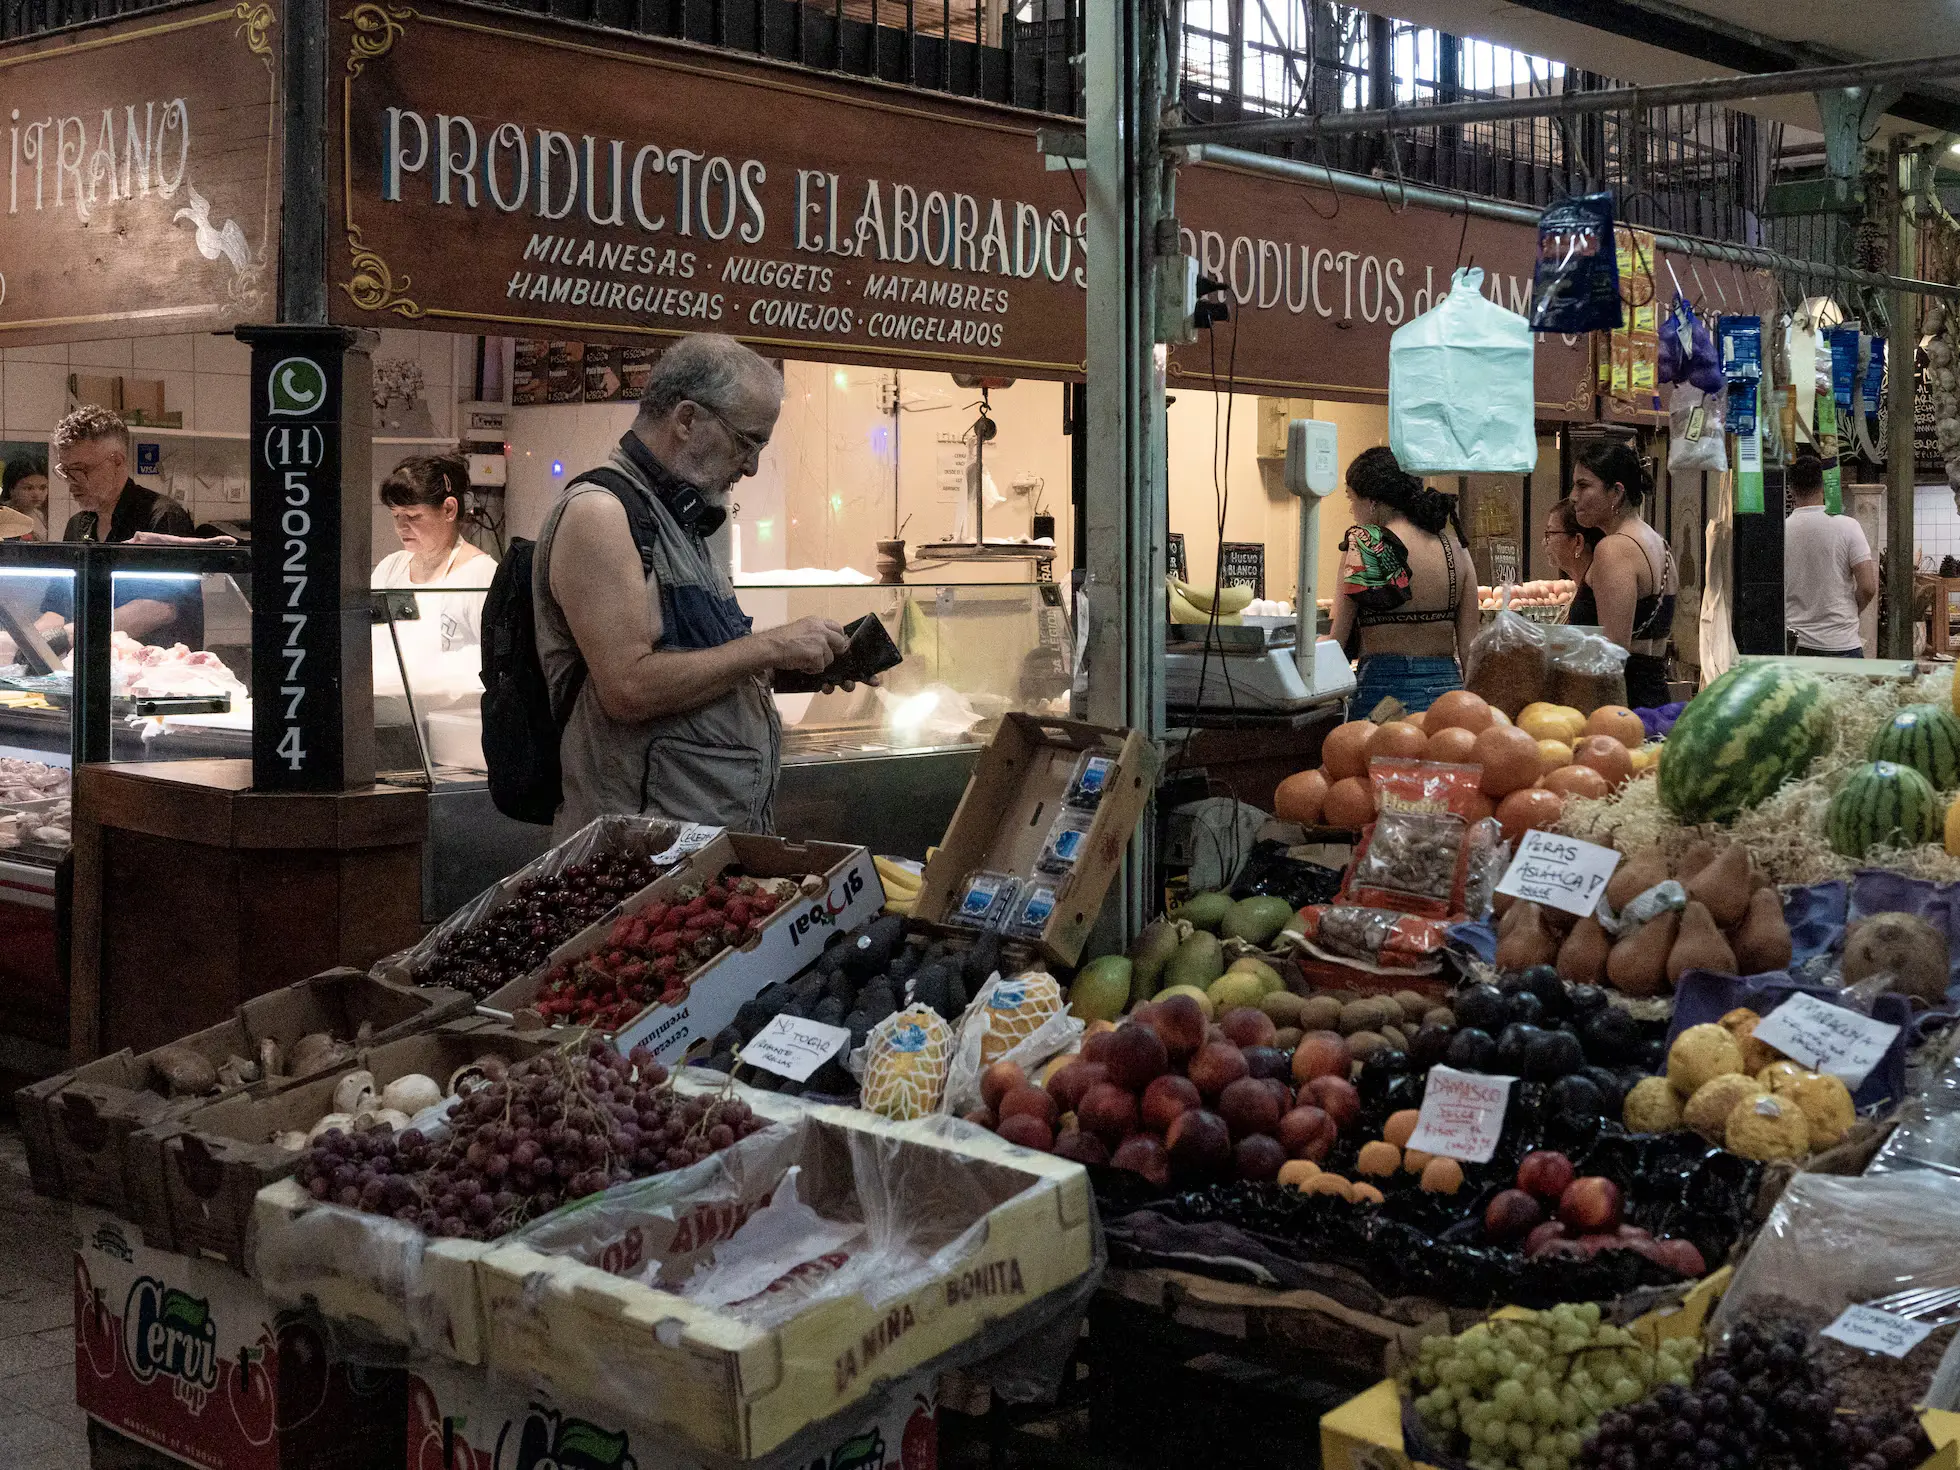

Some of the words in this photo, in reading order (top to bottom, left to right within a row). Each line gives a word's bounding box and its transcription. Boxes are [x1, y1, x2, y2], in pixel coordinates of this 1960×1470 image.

[383, 106, 766, 245] PRODUCTOS
[506, 271, 725, 321] HAMBURGUESAS
[748, 298, 855, 334] CONEJOS
[867, 312, 1004, 348] CONGELADOS
[522, 233, 696, 279] MILANESAS
[720, 256, 834, 294] NUGGETS
[863, 273, 1009, 314] MATAMBRES
[140, 464, 159, 474] VISA
[1226, 563, 1258, 576] BLANCO
[1527, 833, 1578, 862] PERAS
[123, 1276, 216, 1389] Cervi
